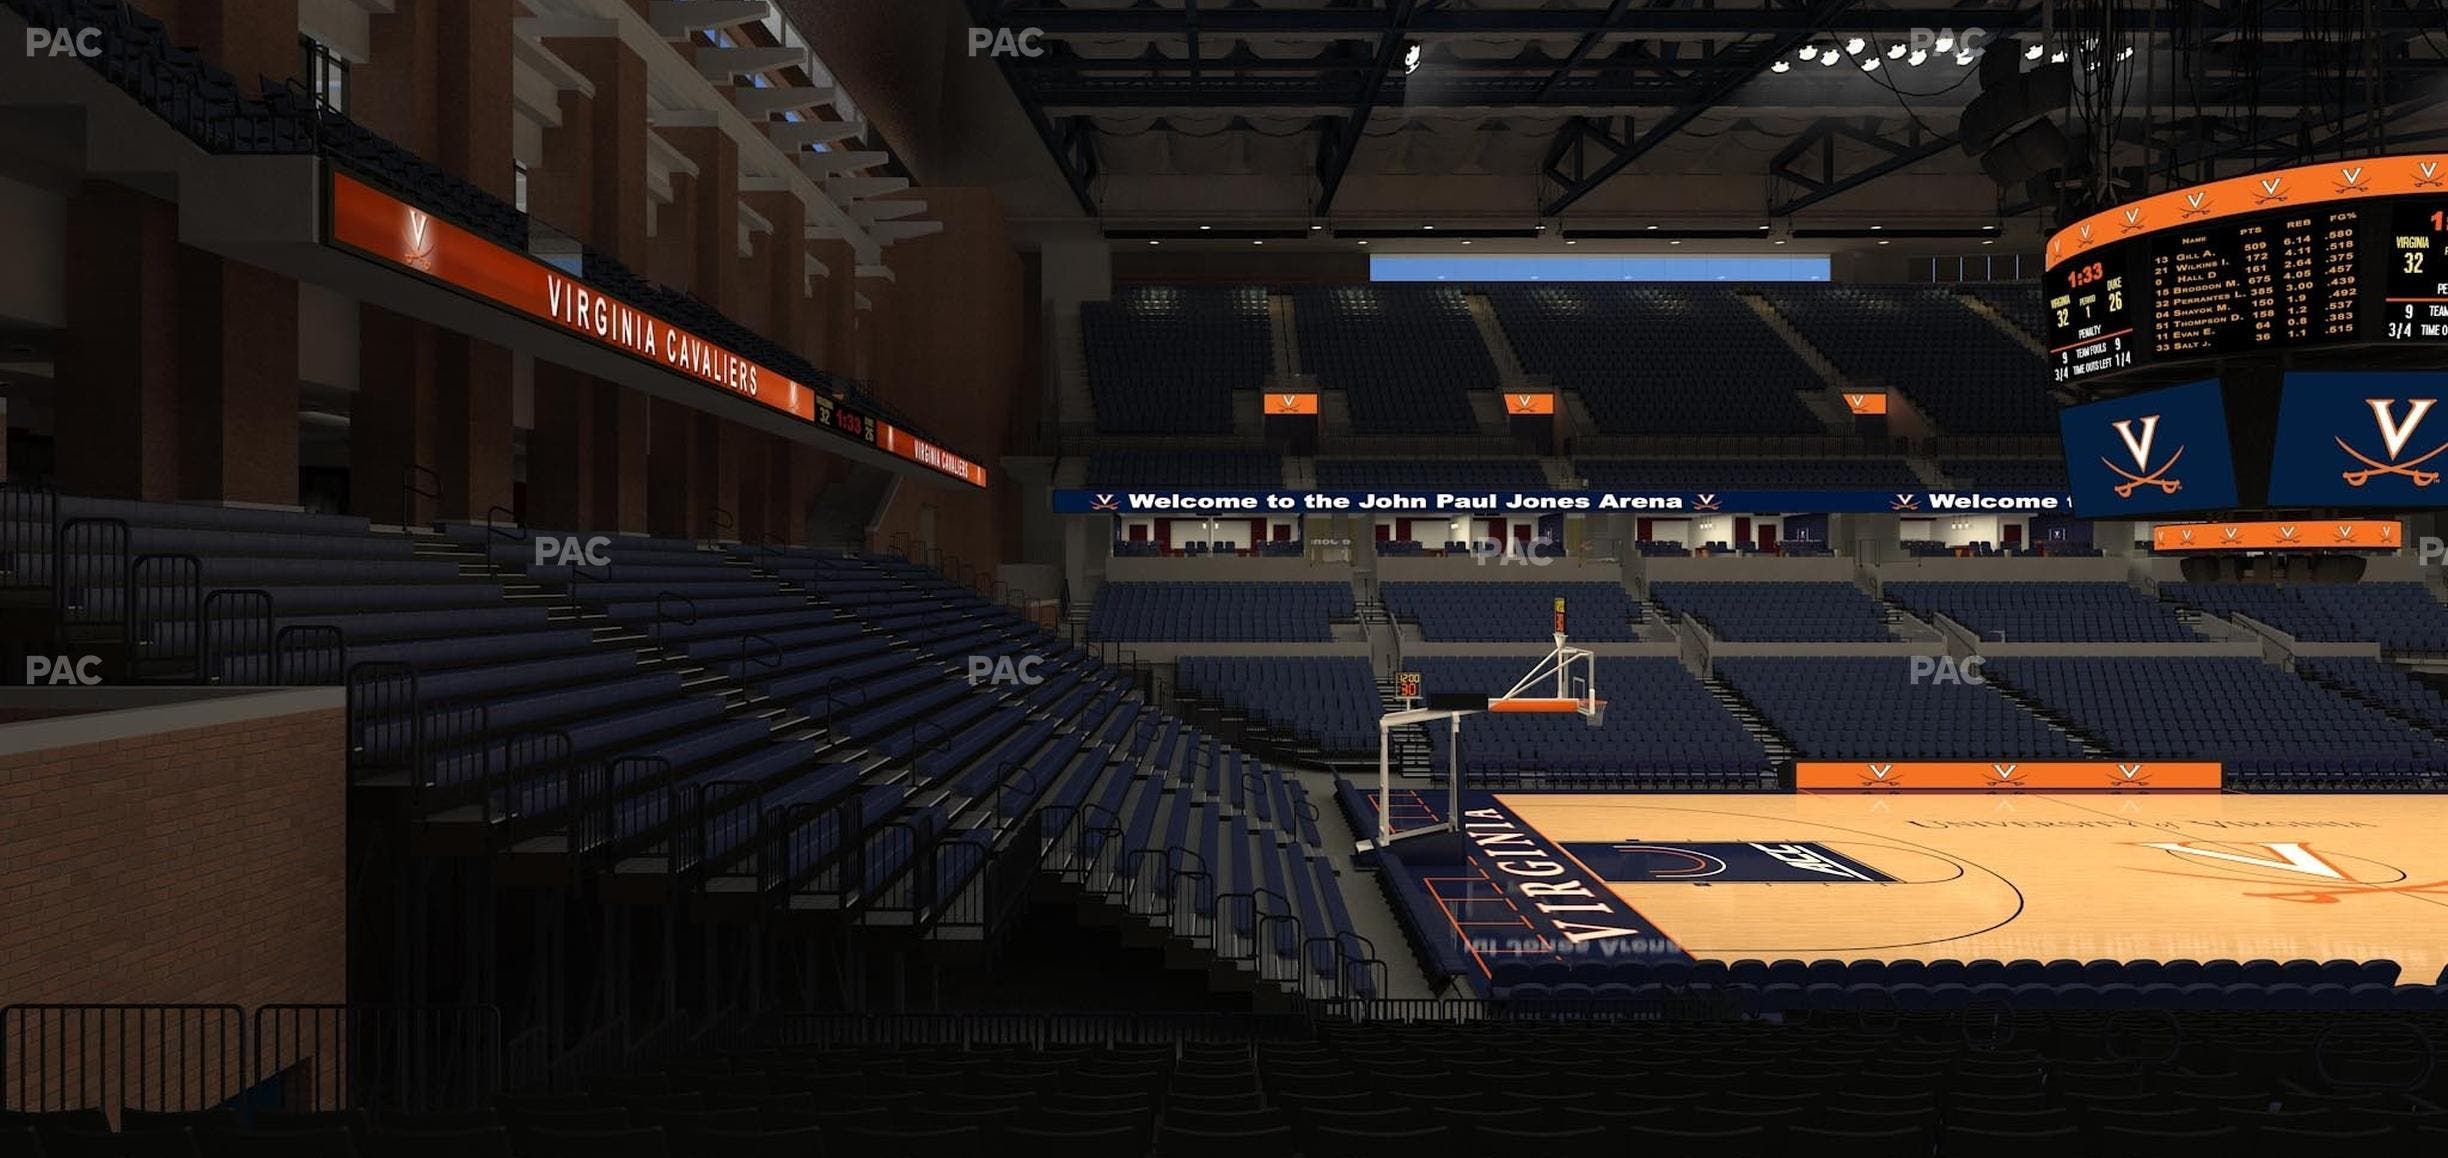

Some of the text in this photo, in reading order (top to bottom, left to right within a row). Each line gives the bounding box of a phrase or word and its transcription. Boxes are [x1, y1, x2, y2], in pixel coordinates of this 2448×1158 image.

[2287, 219, 2311, 229] REB
[2155, 256, 2169, 264] 13
[2283, 235, 2311, 246] 6.14
[2396, 236, 2430, 249] VIRGINIA
[2155, 267, 2168, 275] 21
[2246, 252, 2269, 262] 172
[2285, 246, 2311, 256] 4.11
[2325, 240, 2354, 251] .518
[2245, 264, 2266, 274] 161
[2284, 258, 2312, 269] 2.64
[2325, 252, 2354, 263] .375
[2403, 252, 2424, 274] 32
[2068, 262, 2104, 288] 1:33
[2156, 288, 2170, 297] 15
[2248, 275, 2271, 284] 675
[2283, 269, 2311, 280] 4.05
[2324, 264, 2353, 275] .457
[2155, 300, 2170, 308] 32
[2250, 286, 2273, 296] 385
[2286, 281, 2313, 291] 3.00
[2156, 311, 2170, 319] 04
[2251, 298, 2274, 307] 150
[2287, 294, 2306, 303] 1.9
[2328, 288, 2357, 298] .492
[2056, 291, 2123, 328] 32 1 26
[2156, 322, 2169, 330] 51
[2287, 305, 2307, 315] 1.2
[2324, 300, 2353, 311] .537
[2404, 304, 2414, 319] 9
[548, 274, 757, 395] VIRGINIA CAVALIERS
[2156, 332, 2169, 341] 11
[2255, 321, 2271, 330] 64
[2324, 311, 2353, 322] .383
[2156, 343, 2170, 352] 33
[2255, 332, 2271, 342] 36
[2288, 329, 2306, 338] 1.1
[2324, 323, 2353, 334] .515
[2388, 322, 2411, 339] 3/4
[2420, 323, 2440, 336] TIME
[2062, 351, 2068, 364] 9
[2115, 337, 2121, 351] 9
[2054, 365, 2069, 382] 3/4
[2115, 350, 2131, 367] 1/4
[1128, 493, 1683, 509] Welcome to the John Paul Jones Arena
[1928, 493, 2059, 509] Welcome
[1401, 683, 1417, 696] 30
[1464, 807, 1640, 944] VIRGINIA
